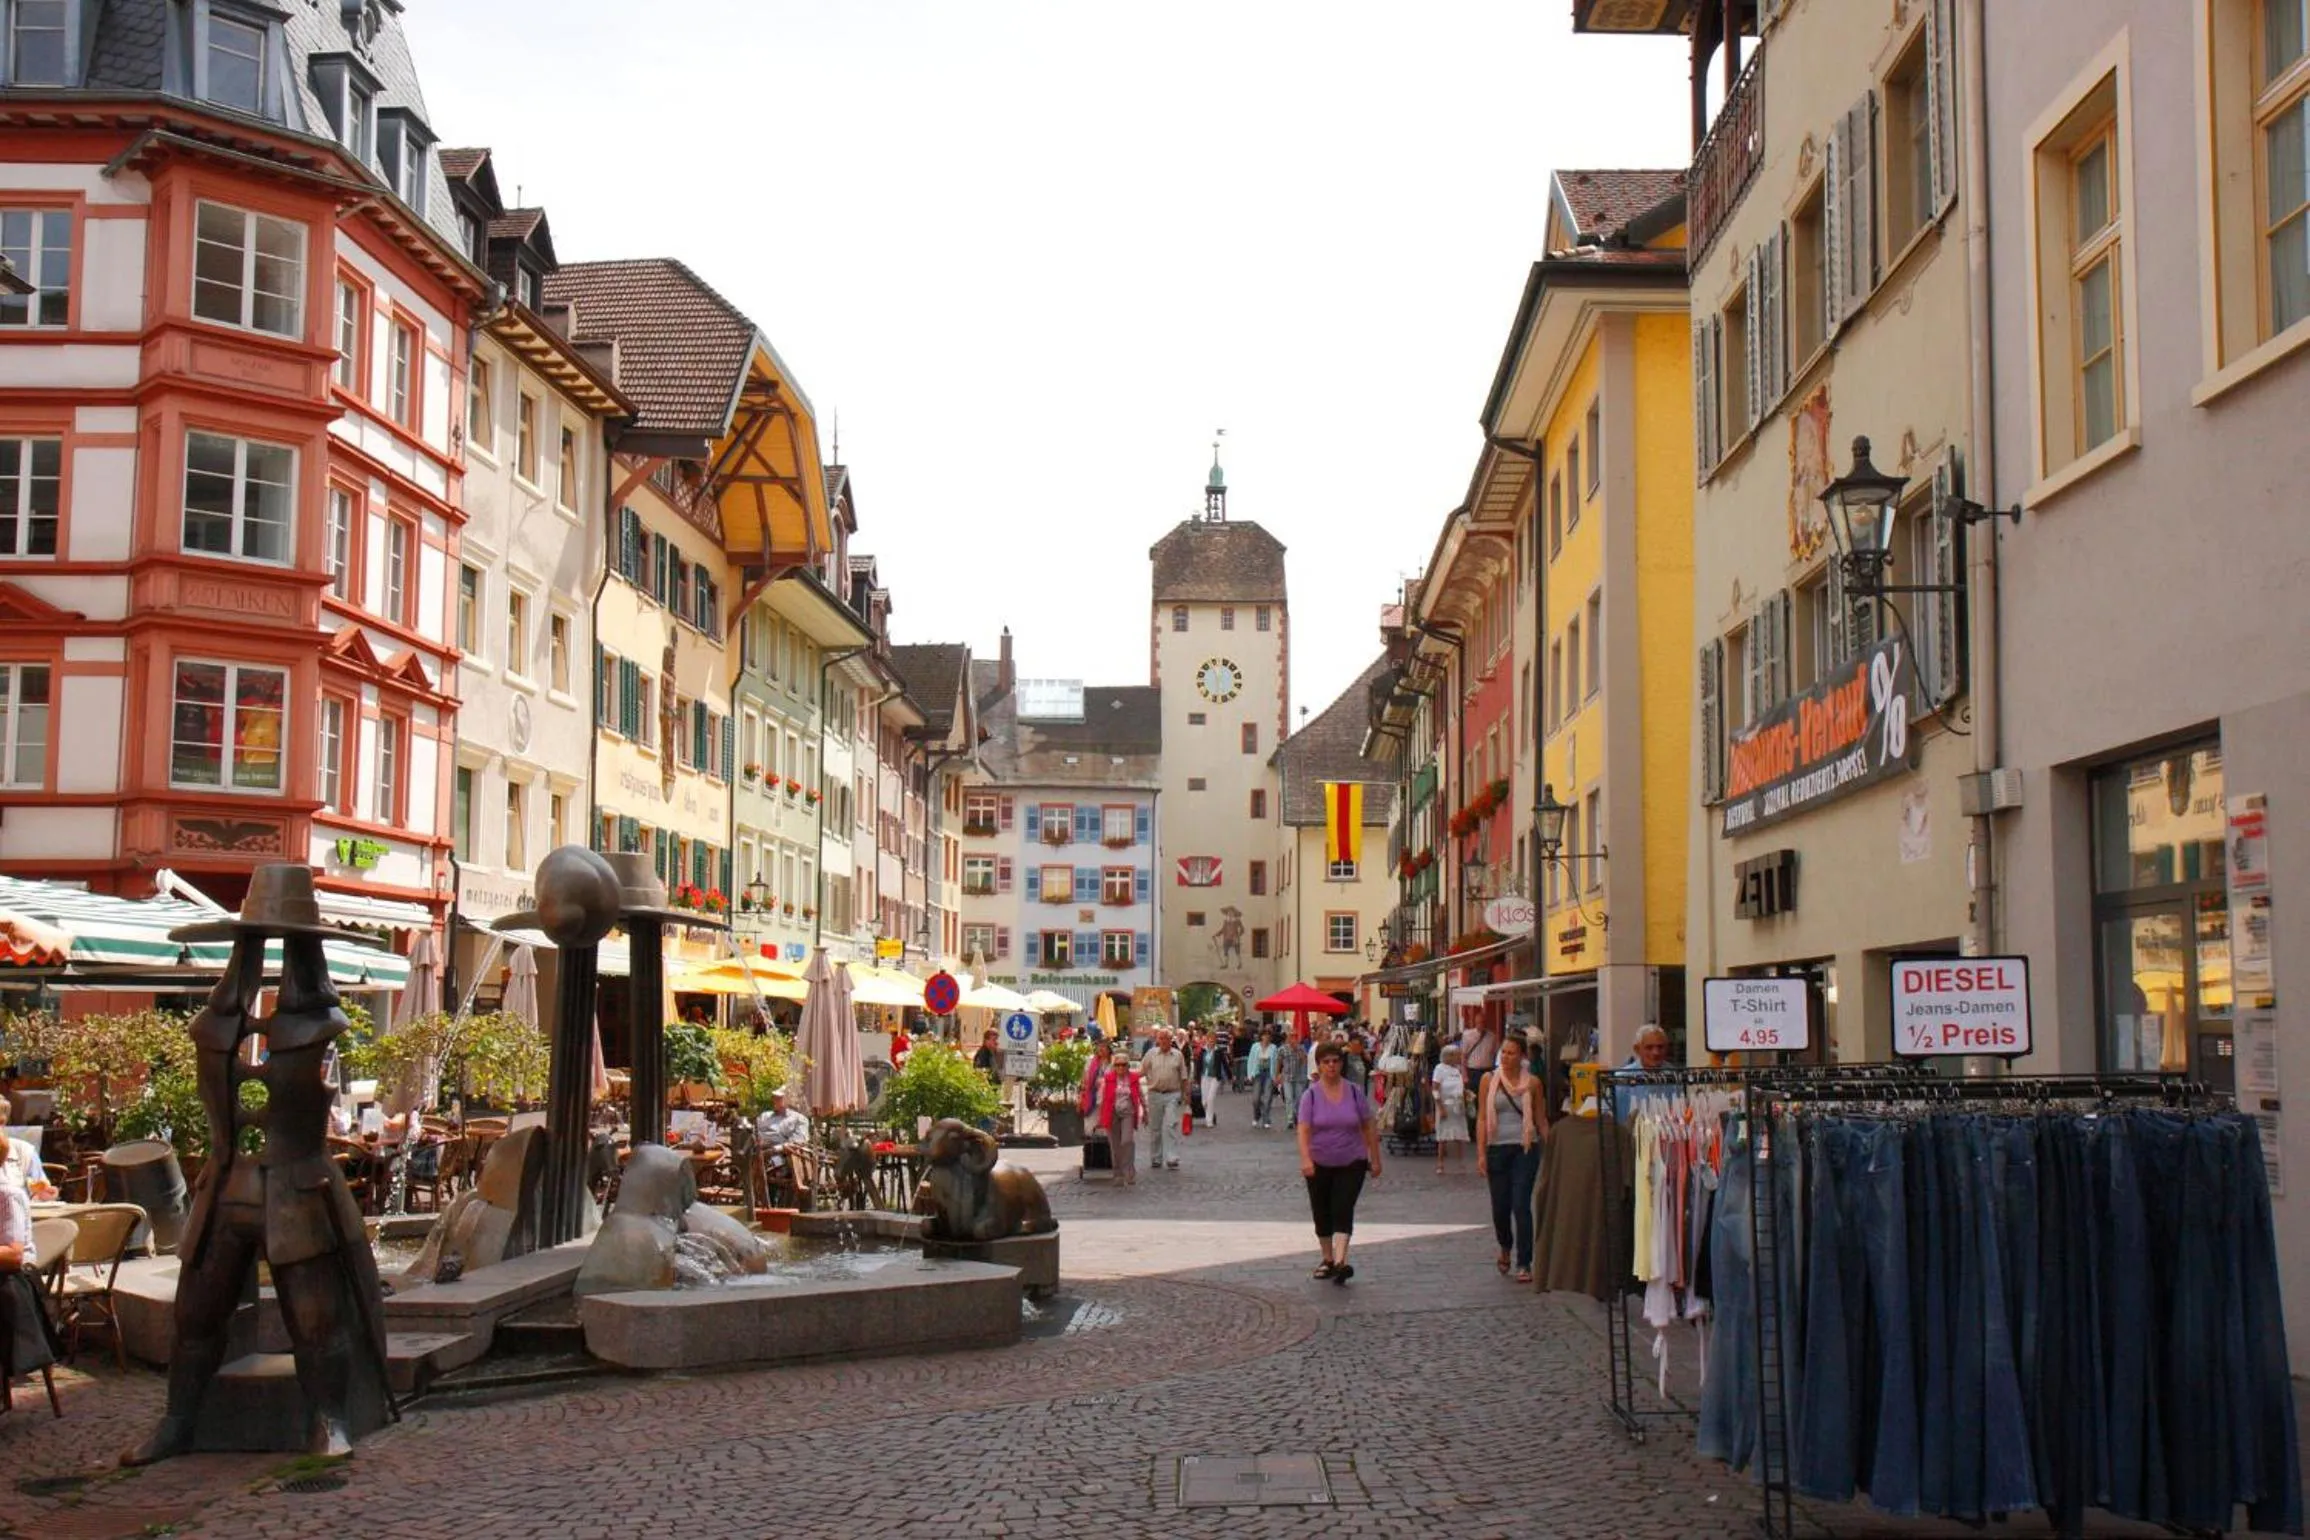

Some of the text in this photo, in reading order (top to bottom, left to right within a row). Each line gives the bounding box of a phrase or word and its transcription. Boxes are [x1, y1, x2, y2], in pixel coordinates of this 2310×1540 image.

[1031, 973, 1119, 986] Reformhaus
[1904, 967, 2015, 993] DIESEL
[1736, 983, 1779, 994] Damen
[1731, 999, 1786, 1012] T-Shirt
[1906, 1001, 2015, 1016] Jeans-Damen
[1740, 1029, 1778, 1046] 4,95
[1942, 1022, 2016, 1046] Preis
